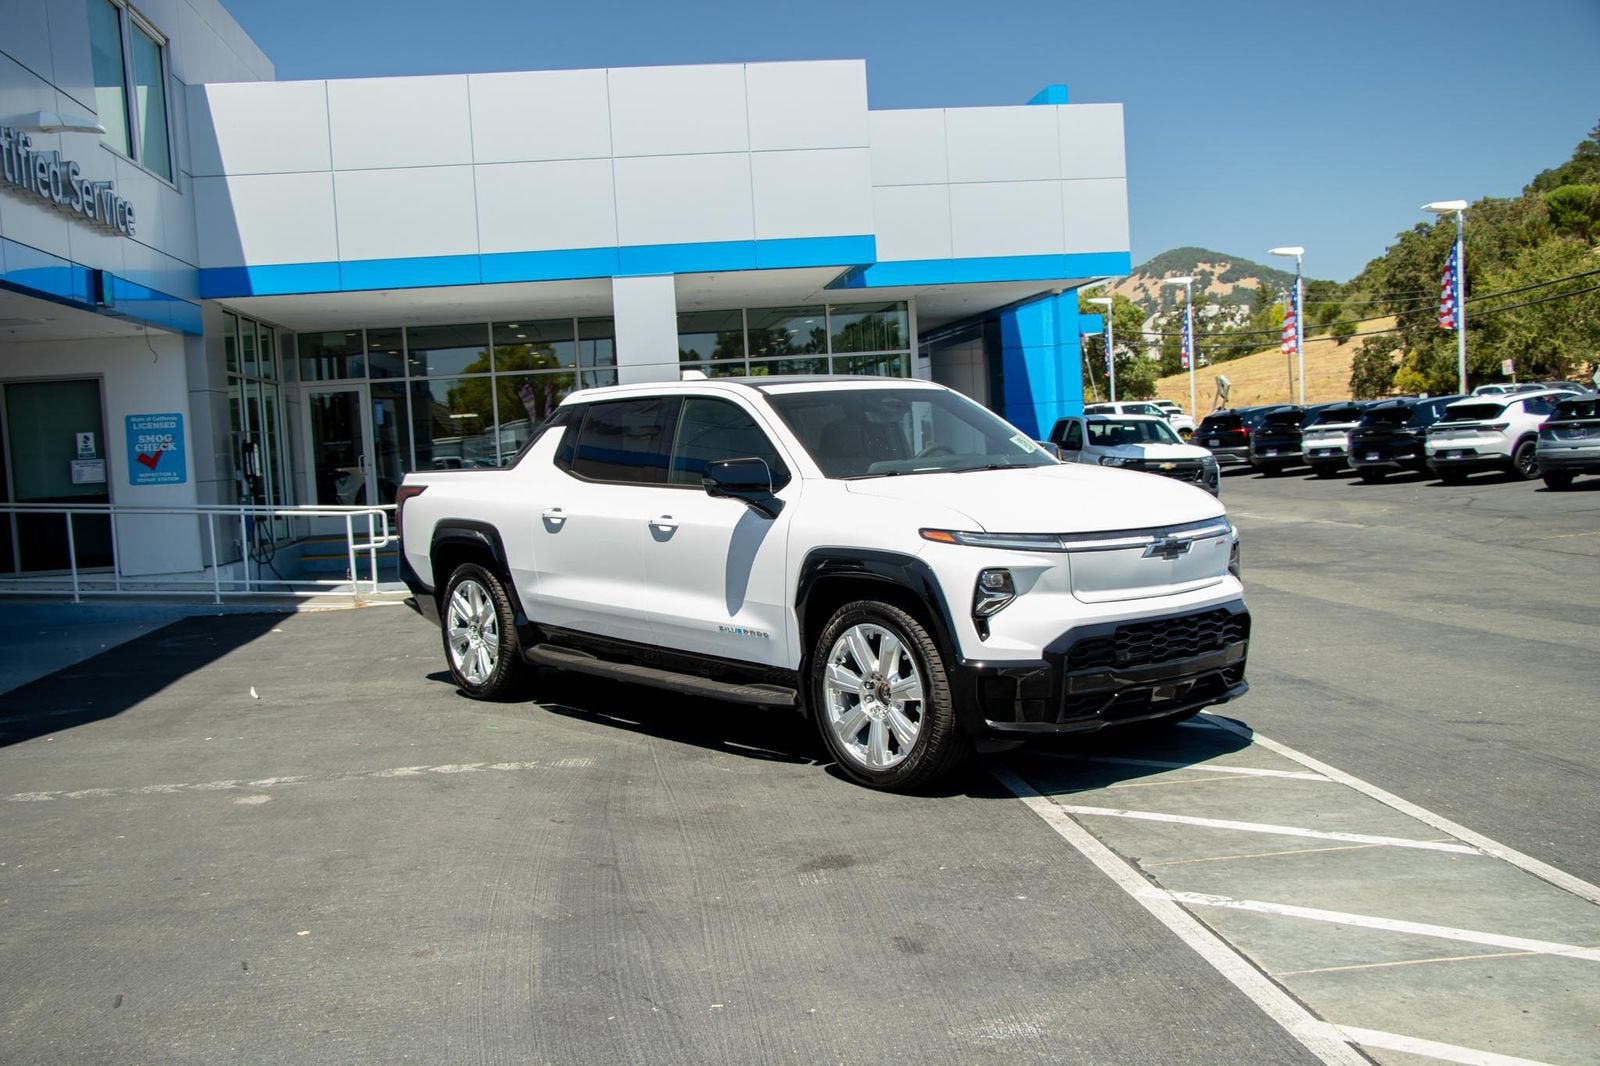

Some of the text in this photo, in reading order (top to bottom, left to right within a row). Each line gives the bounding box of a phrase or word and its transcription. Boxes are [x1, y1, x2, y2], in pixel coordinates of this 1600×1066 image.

[68, 160, 136, 237] Service
[133, 422, 176, 430] LICENSED
[138, 434, 173, 443] SMOG
[135, 442, 177, 452] CHECK
